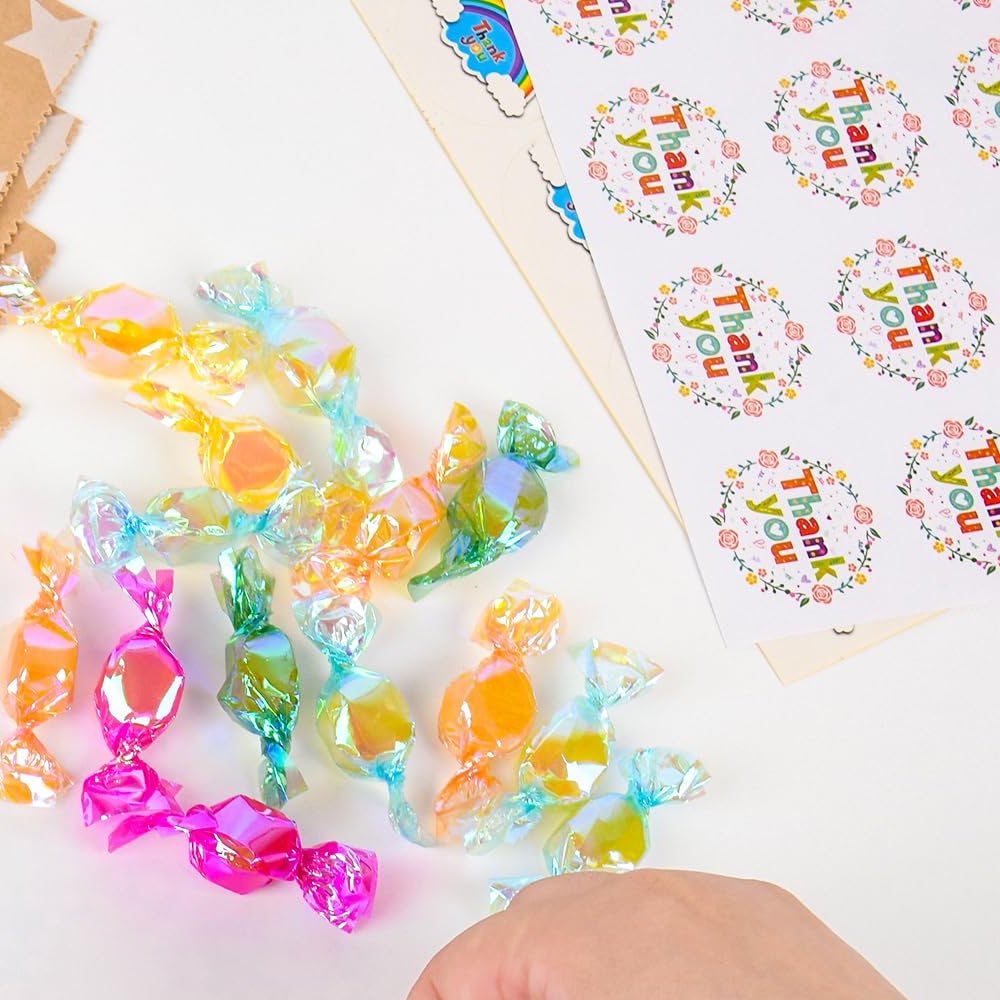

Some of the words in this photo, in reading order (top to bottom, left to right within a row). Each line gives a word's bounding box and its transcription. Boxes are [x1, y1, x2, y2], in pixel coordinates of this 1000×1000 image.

[460, 34, 488, 63] you
[472, 19, 506, 64] Thank
[615, 128, 665, 196] you
[650, 105, 711, 213] Thank
[798, 102, 848, 169] you
[832, 79, 894, 186] Thank
[678, 310, 729, 378] you
[713, 285, 776, 396] Thank
[862, 281, 913, 350] you
[897, 256, 960, 366] Thank
[930, 464, 983, 534] you
[965, 438, 1000, 538] Than
[746, 493, 799, 565] you
[780, 468, 845, 582] Thank
